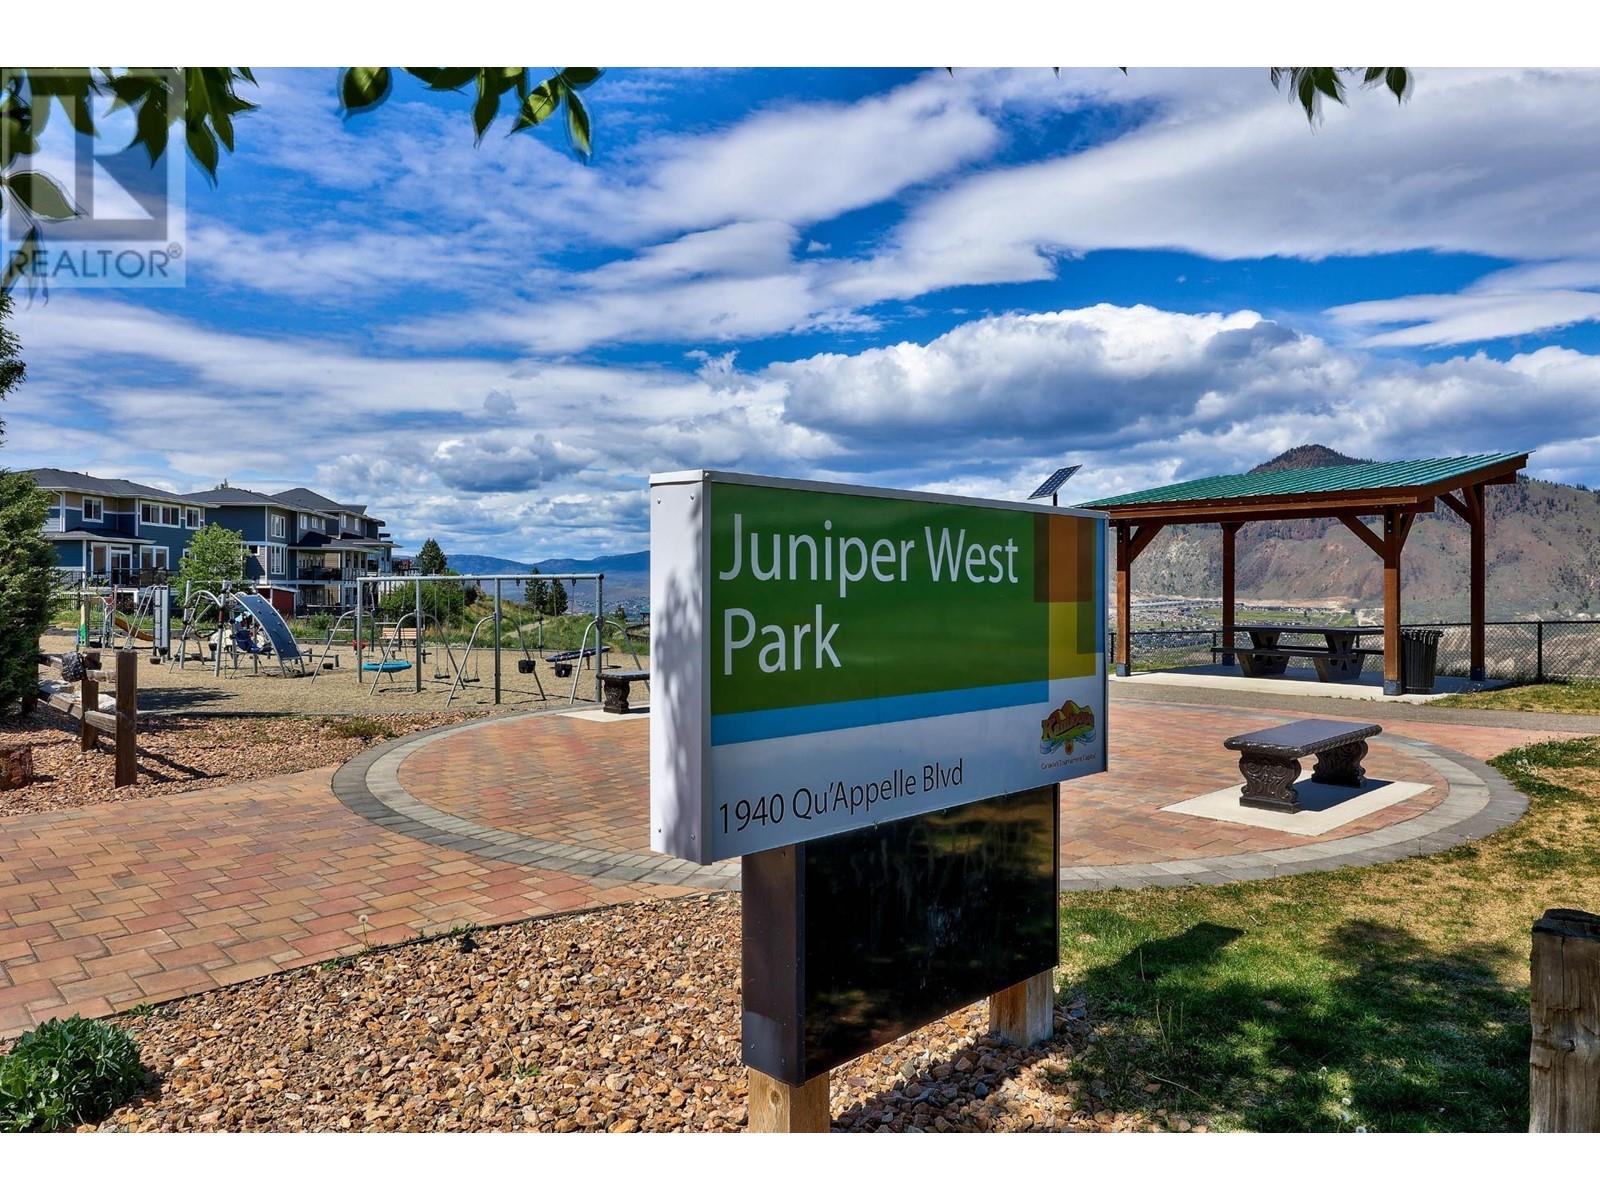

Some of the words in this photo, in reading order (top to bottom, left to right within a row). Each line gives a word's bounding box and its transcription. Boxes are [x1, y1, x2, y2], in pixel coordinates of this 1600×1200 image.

[719, 513, 915, 598] Juniper
[925, 526, 1019, 583] West
[723, 604, 842, 676] Park
[720, 793, 785, 834] 1940
[791, 770, 917, 818] Qu'Appelle
[923, 758, 963, 793] Blvd
